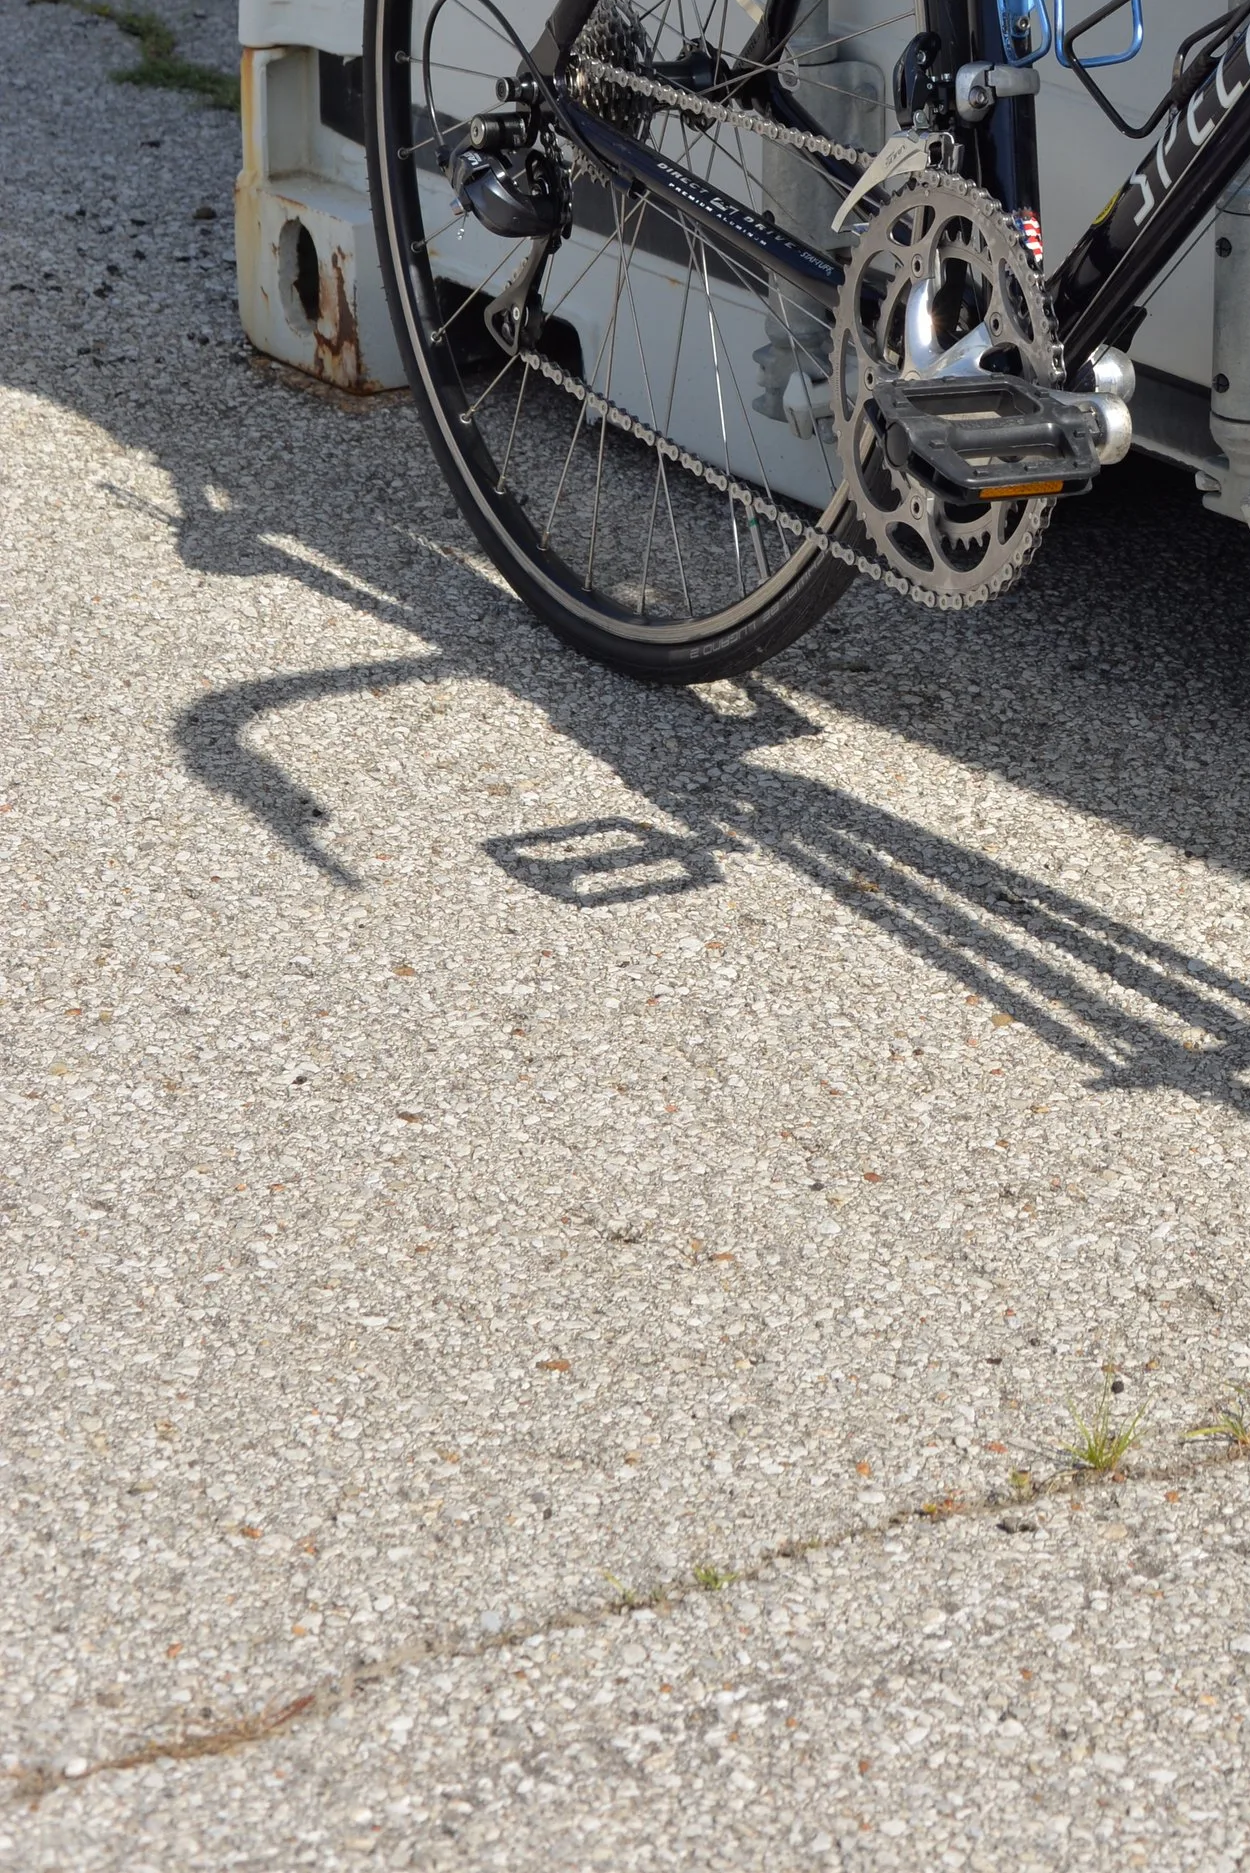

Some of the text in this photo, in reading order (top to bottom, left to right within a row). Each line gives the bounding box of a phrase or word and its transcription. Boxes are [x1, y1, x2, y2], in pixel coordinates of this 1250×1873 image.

[656, 161, 799, 250] DIRECT DRIVE
[668, 181, 714, 213] PREMIUM
